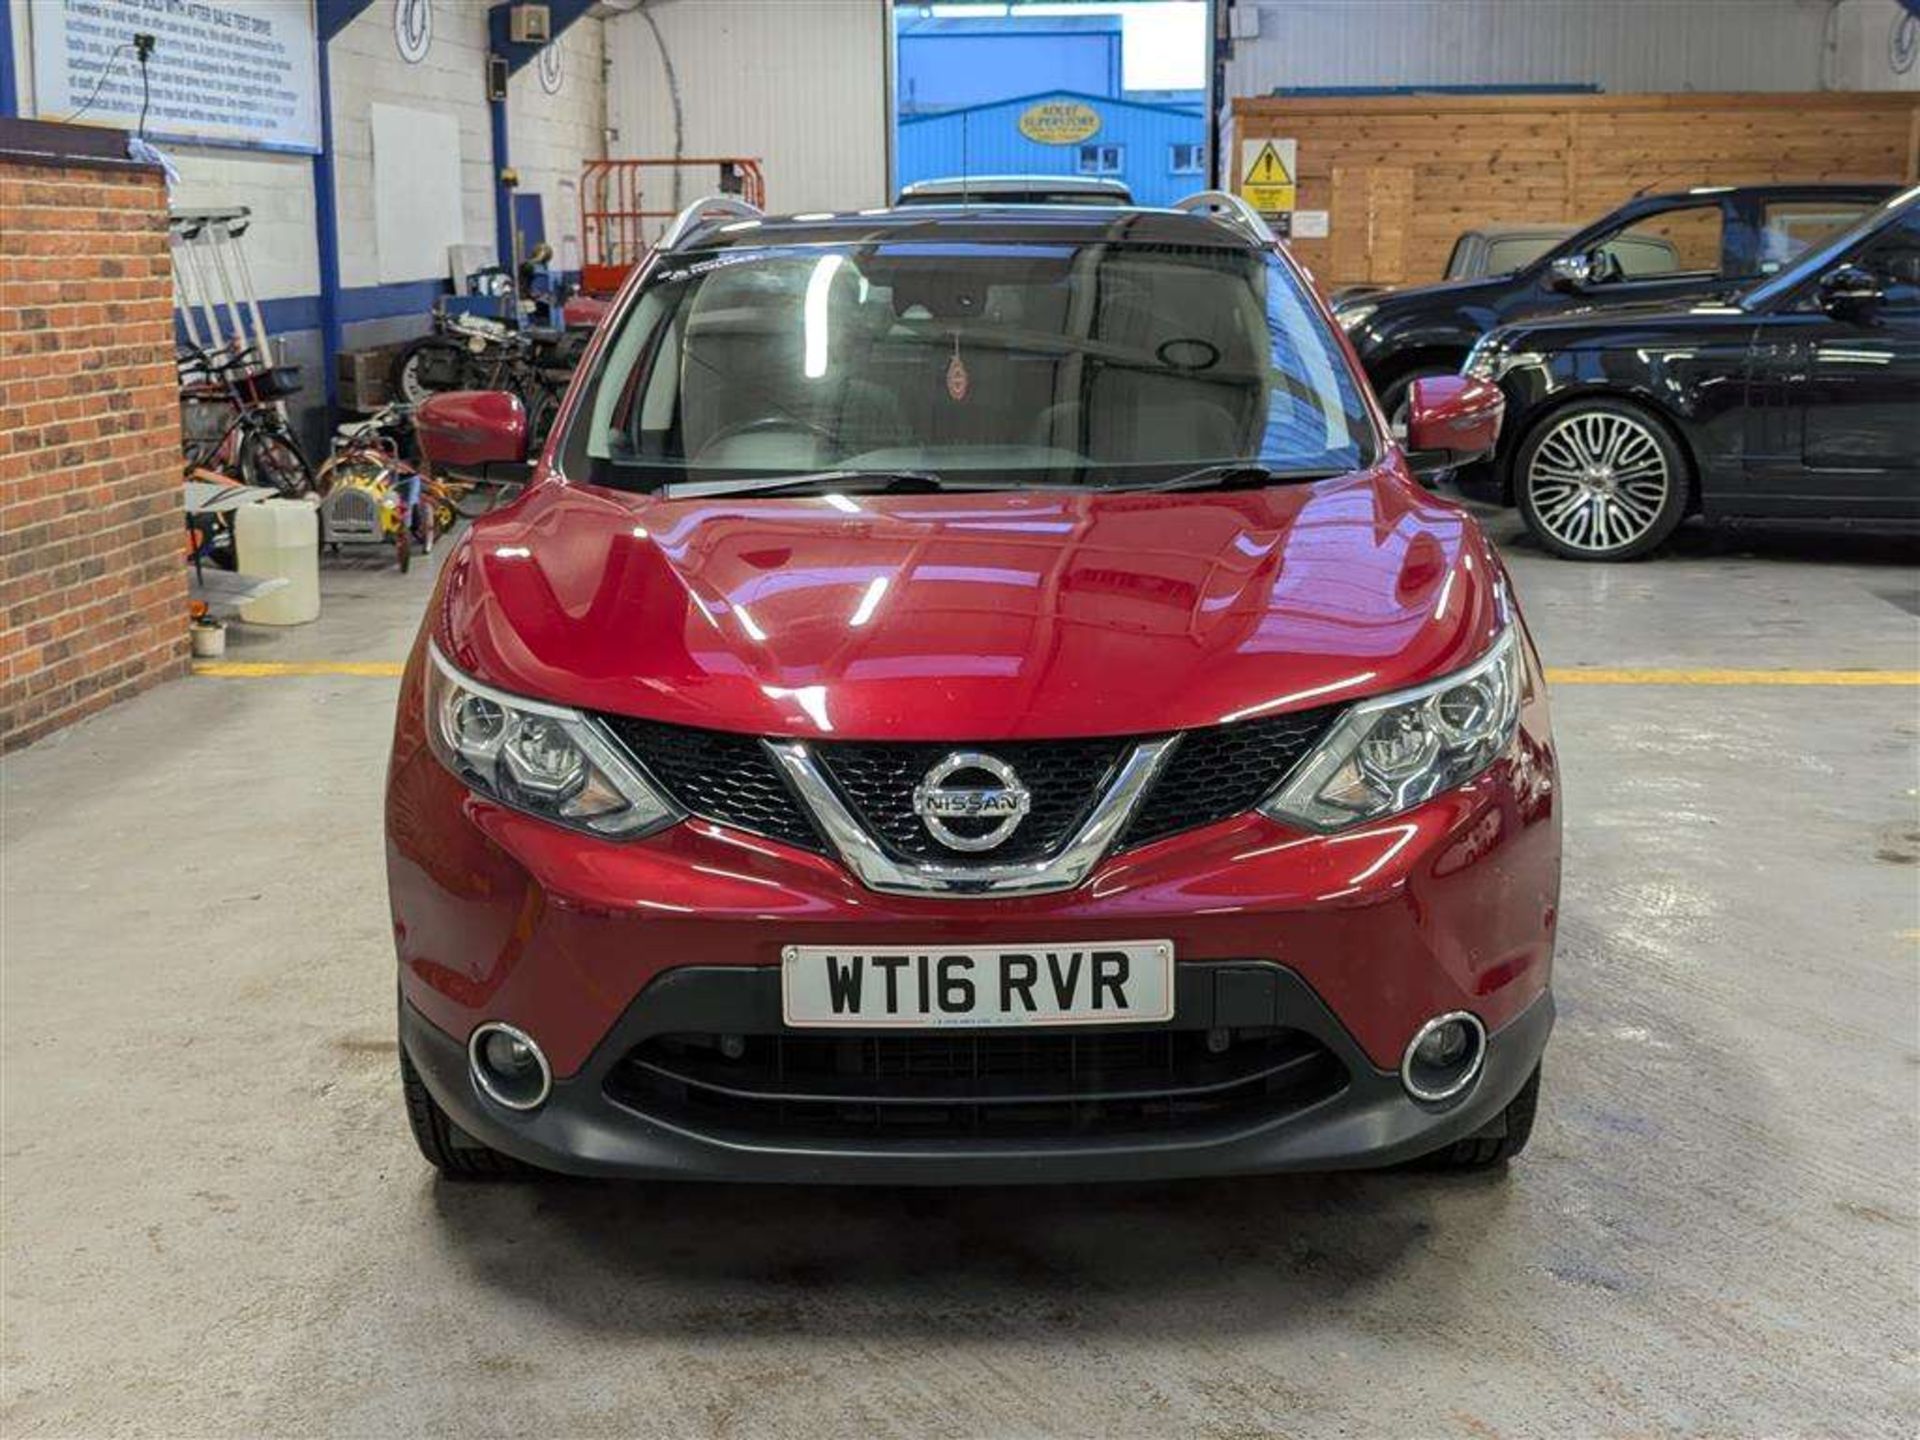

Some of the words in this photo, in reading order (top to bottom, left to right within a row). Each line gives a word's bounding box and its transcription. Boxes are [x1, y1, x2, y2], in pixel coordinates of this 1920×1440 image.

[213, 8, 232, 27] SALE
[233, 13, 250, 31] TEST
[1023, 116, 1096, 128] SUPERSTORE
[926, 794, 1018, 813] NISSAN
[826, 955, 976, 1014] WT16
[1000, 951, 1130, 1012] RVR
